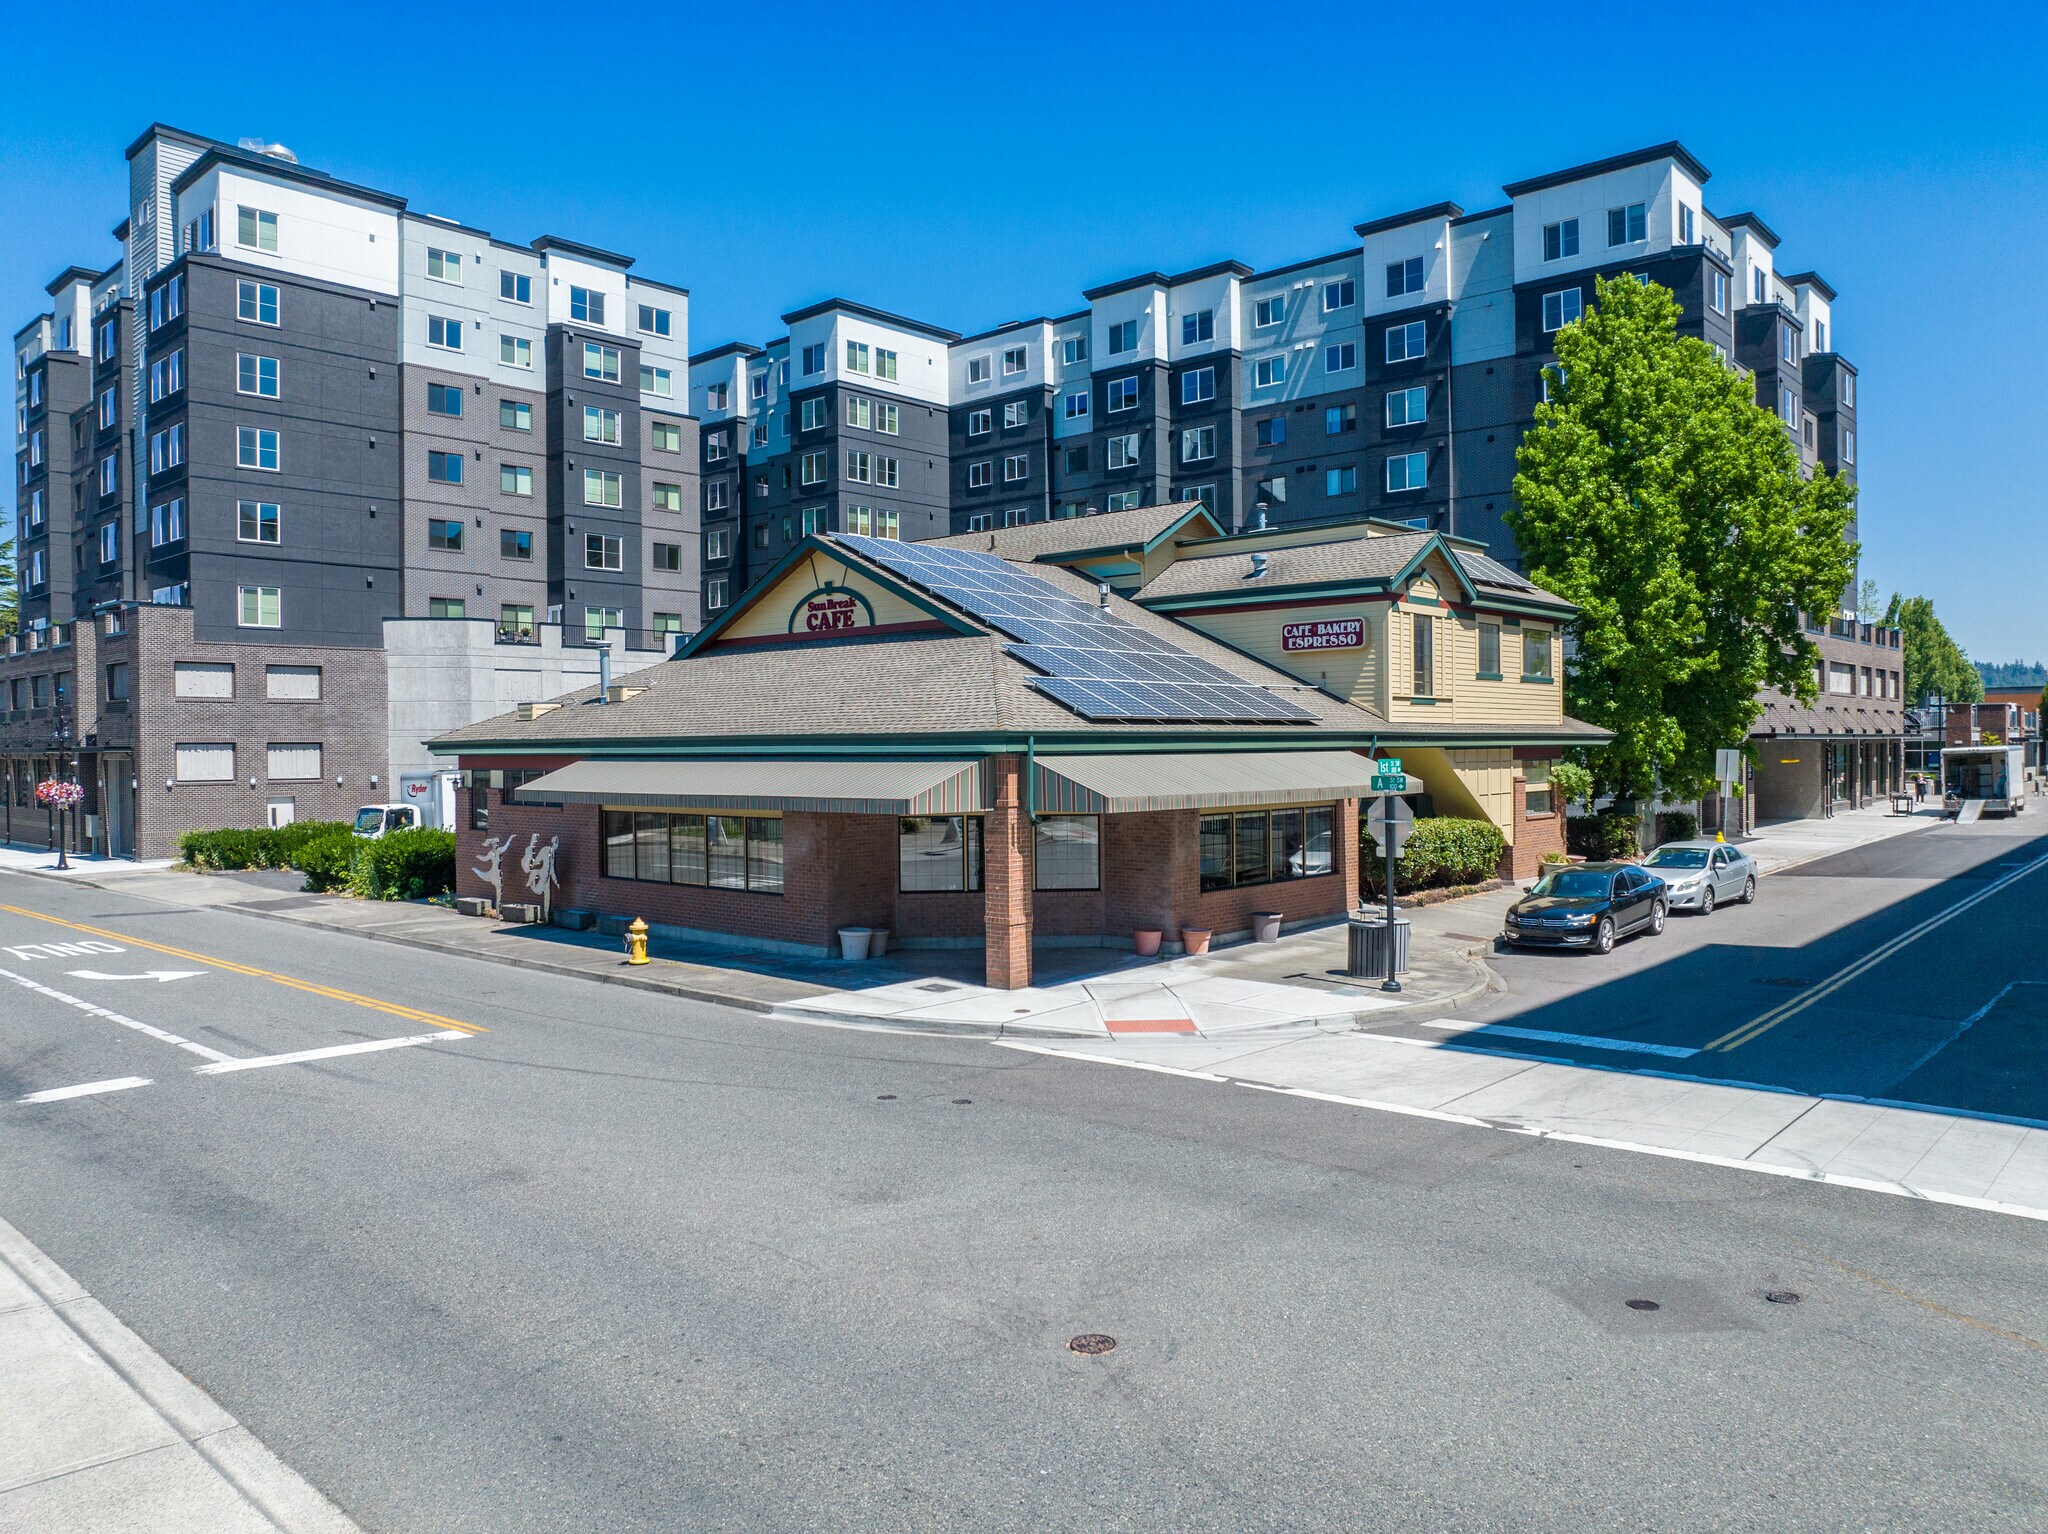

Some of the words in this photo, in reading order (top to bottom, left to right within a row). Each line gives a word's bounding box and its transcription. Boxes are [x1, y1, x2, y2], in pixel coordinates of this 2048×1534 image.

[806, 609, 855, 631] CAFE
[1284, 625, 1311, 636] CAFE
[1318, 621, 1361, 634] BAKERY
[1288, 634, 1357, 649] ESPRESSO
[1380, 761, 1389, 773] 1st
[411, 784, 427, 794] Ryder
[1377, 777, 1384, 789] A
